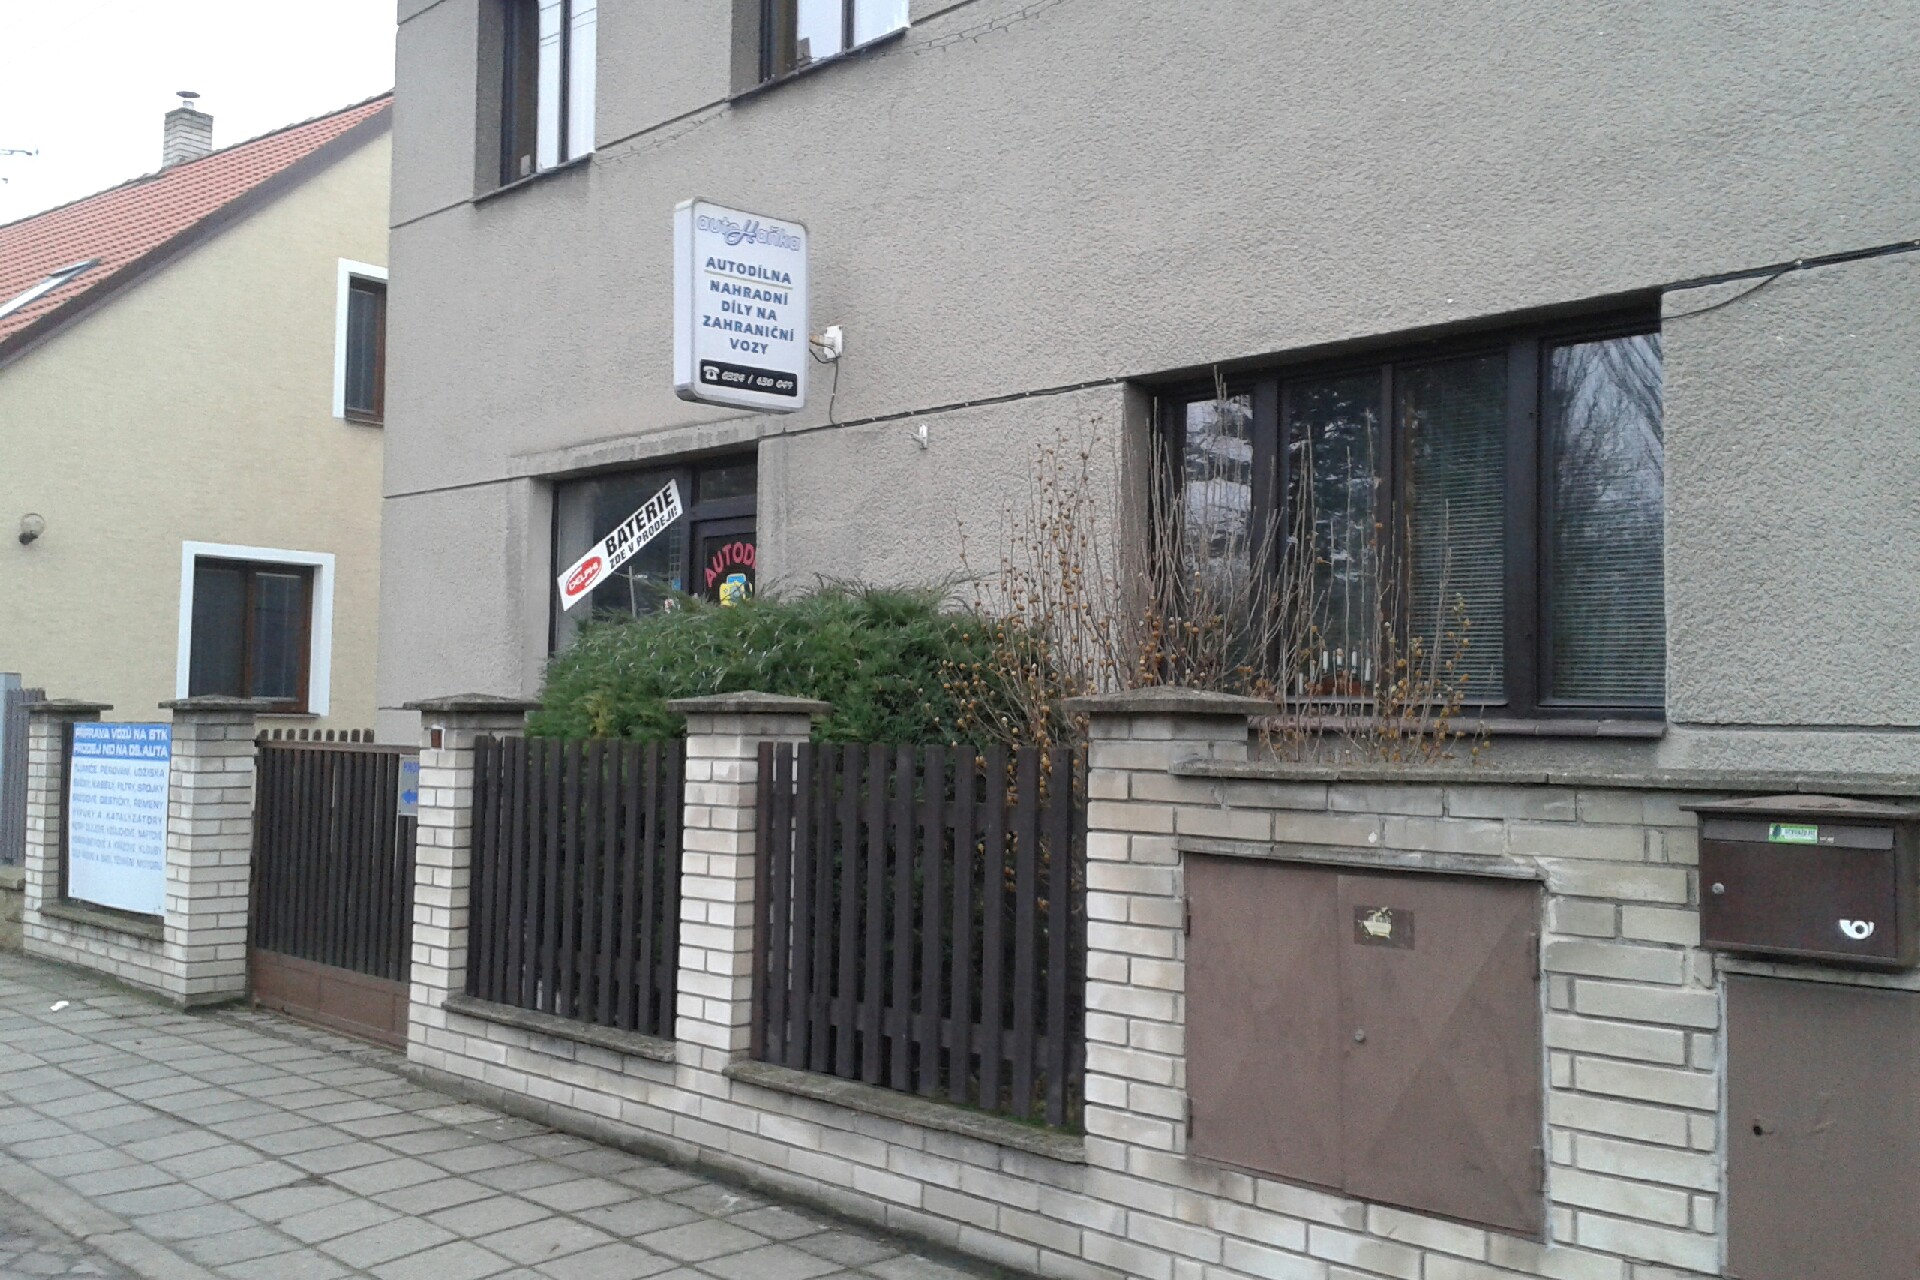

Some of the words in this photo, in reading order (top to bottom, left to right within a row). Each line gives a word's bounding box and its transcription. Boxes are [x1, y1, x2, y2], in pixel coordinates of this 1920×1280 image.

[706, 256, 792, 285] AUTODÍLNA
[721, 299, 753, 317] DÍLY
[757, 306, 777, 321] NA
[702, 314, 794, 342] ZAHRANIČNÍ
[729, 337, 769, 355] VOZY
[605, 484, 675, 558] BATERIE
[610, 548, 627, 570] ZDE
[628, 541, 634, 554] V
